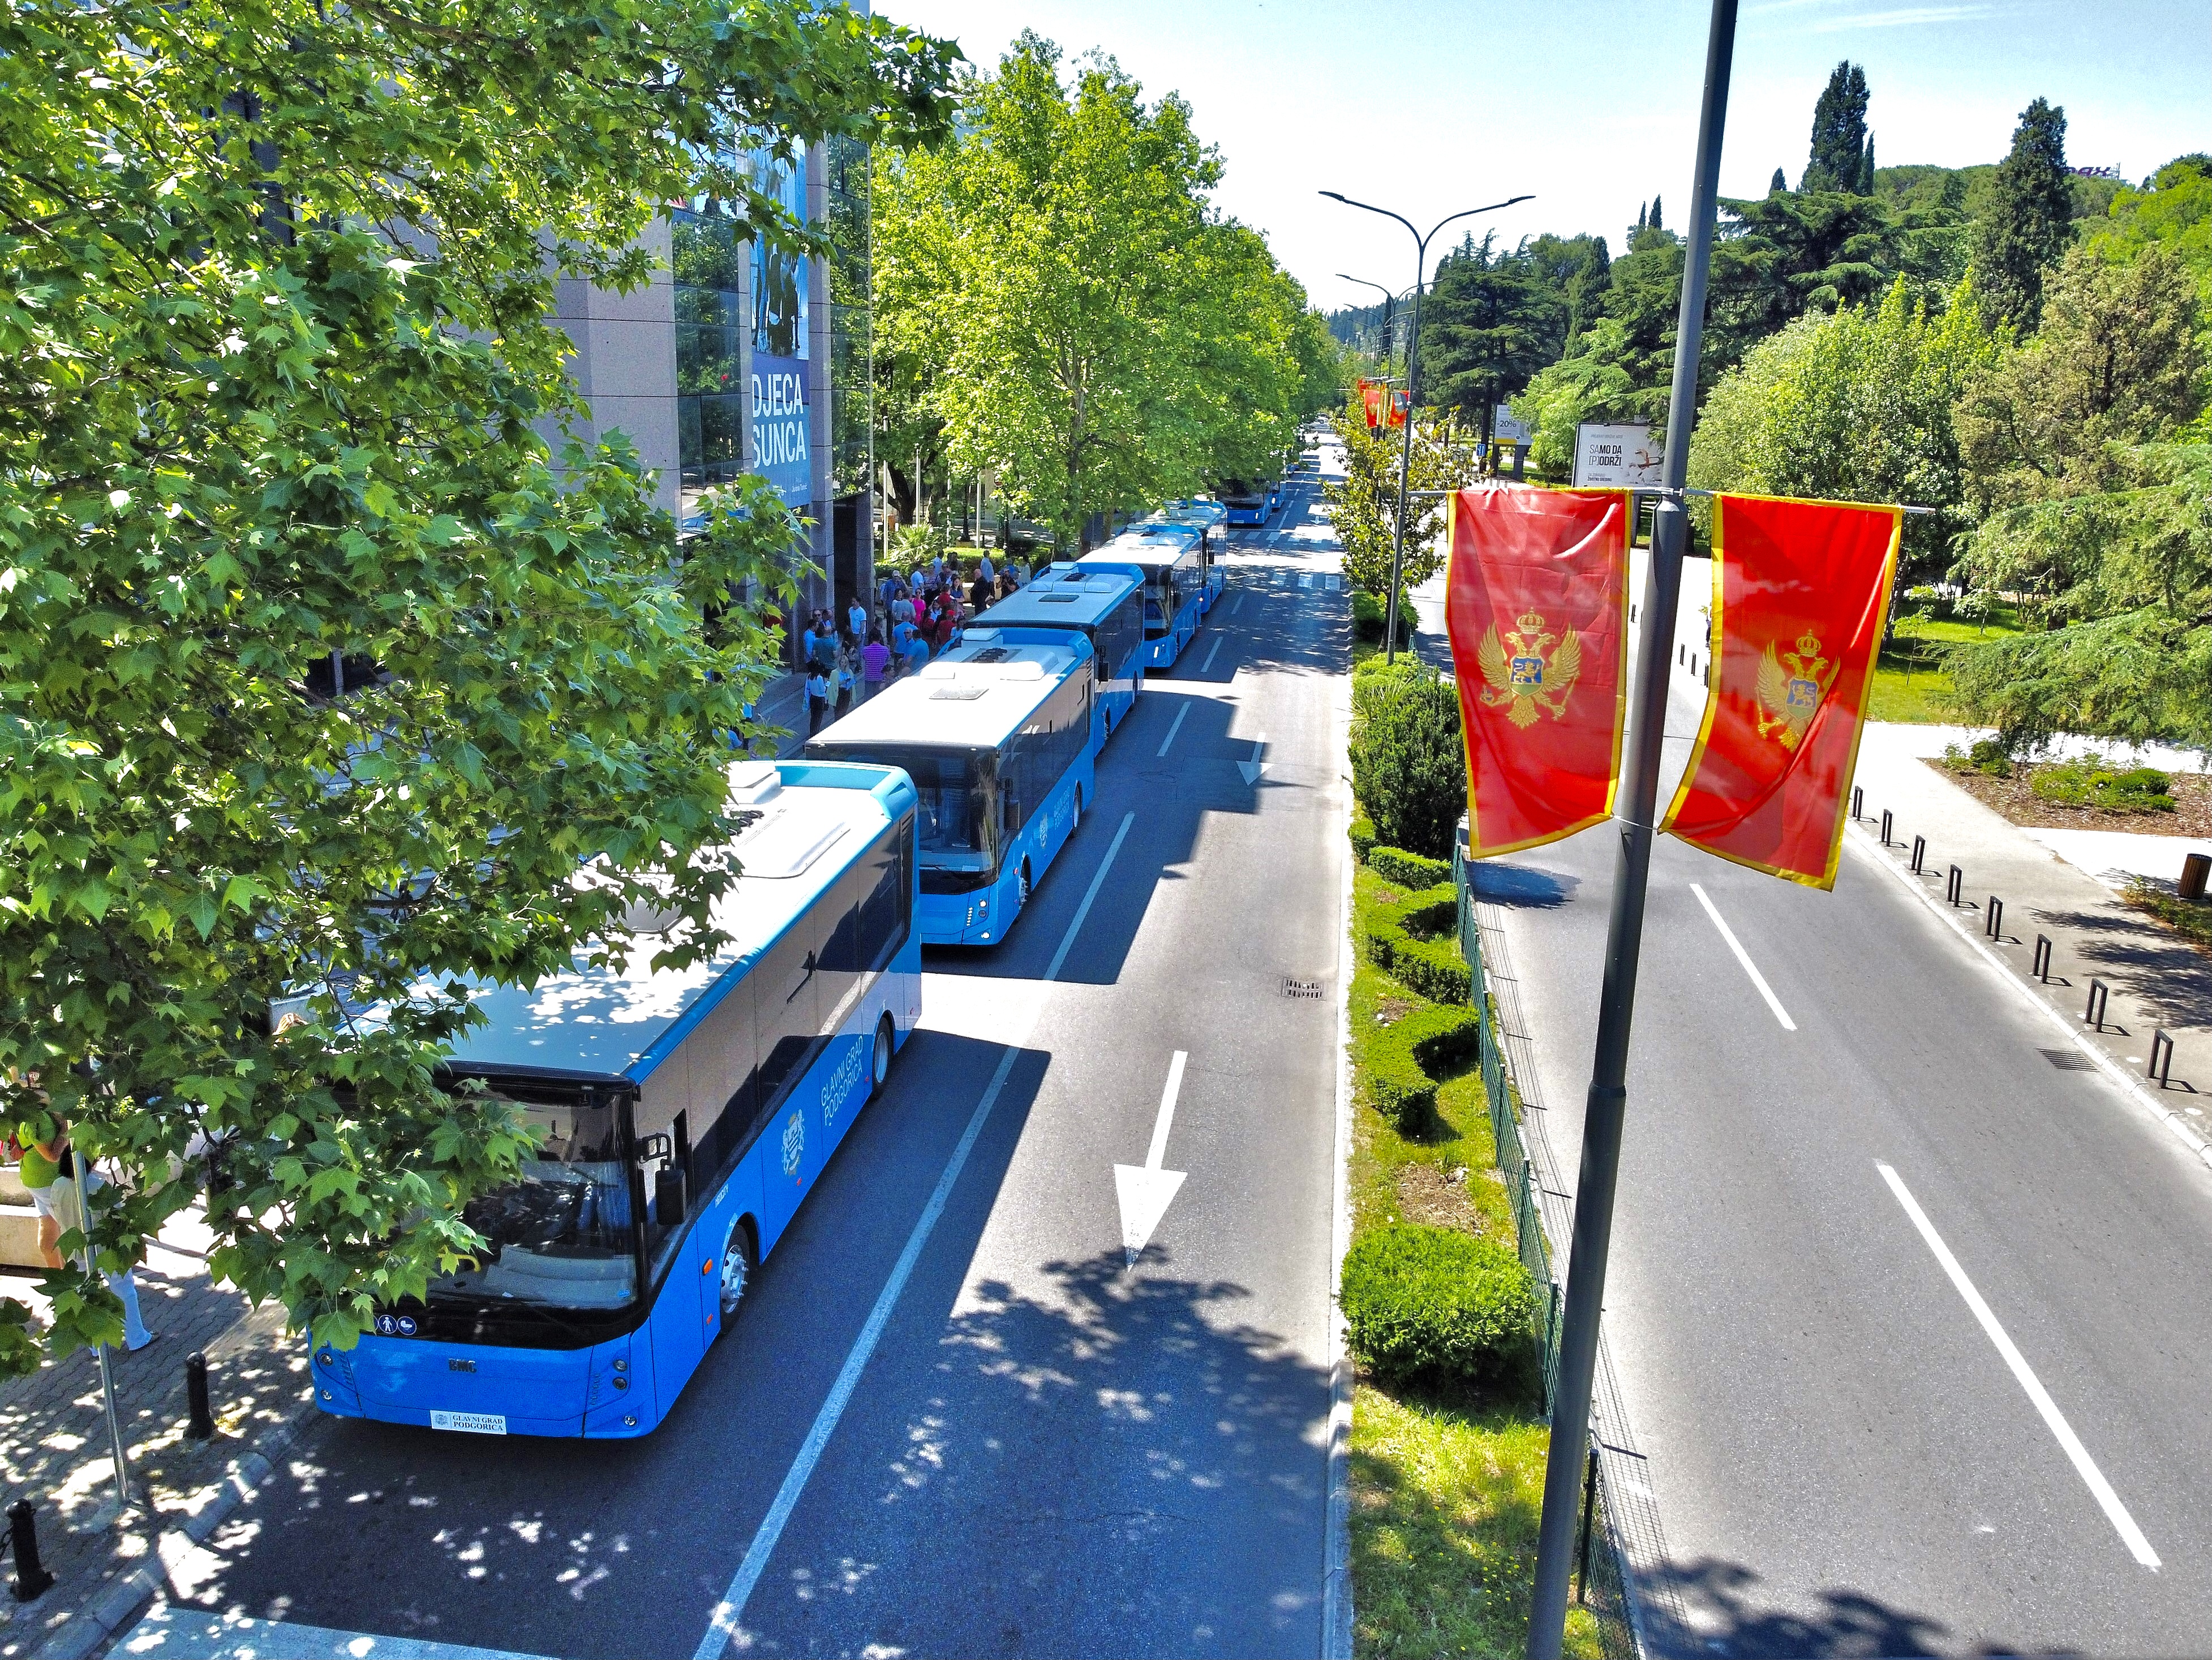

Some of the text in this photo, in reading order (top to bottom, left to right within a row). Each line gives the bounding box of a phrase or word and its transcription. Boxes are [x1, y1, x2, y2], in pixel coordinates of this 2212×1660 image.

[752, 373, 804, 418] DJECA
[751, 421, 806, 469] SUNCA
[1588, 454, 1622, 466] [P]ODRŽI
[1590, 444, 1622, 454] SAMO DA
[821, 1035, 863, 1106] GLAVNI GRAD
[824, 1058, 862, 1126] PODGORICA
[454, 1421, 504, 1431] PODGORICA
